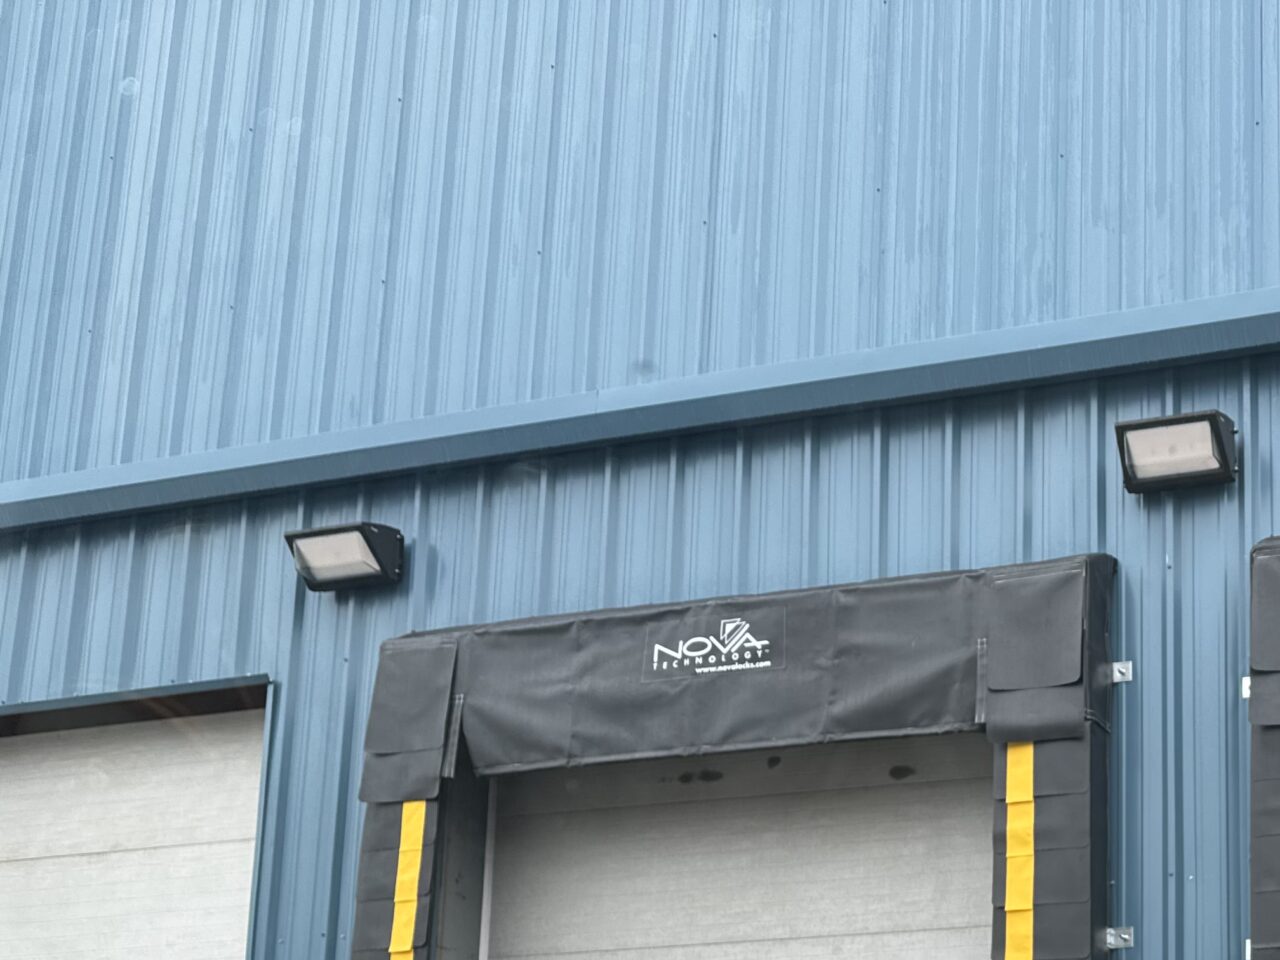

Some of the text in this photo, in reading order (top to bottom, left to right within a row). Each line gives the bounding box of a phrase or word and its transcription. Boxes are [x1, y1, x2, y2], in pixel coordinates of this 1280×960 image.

[653, 623, 770, 663] NOVA
[652, 649, 763, 671] TECHNOLOGY
[694, 660, 771, 674] www.novalocks.com
